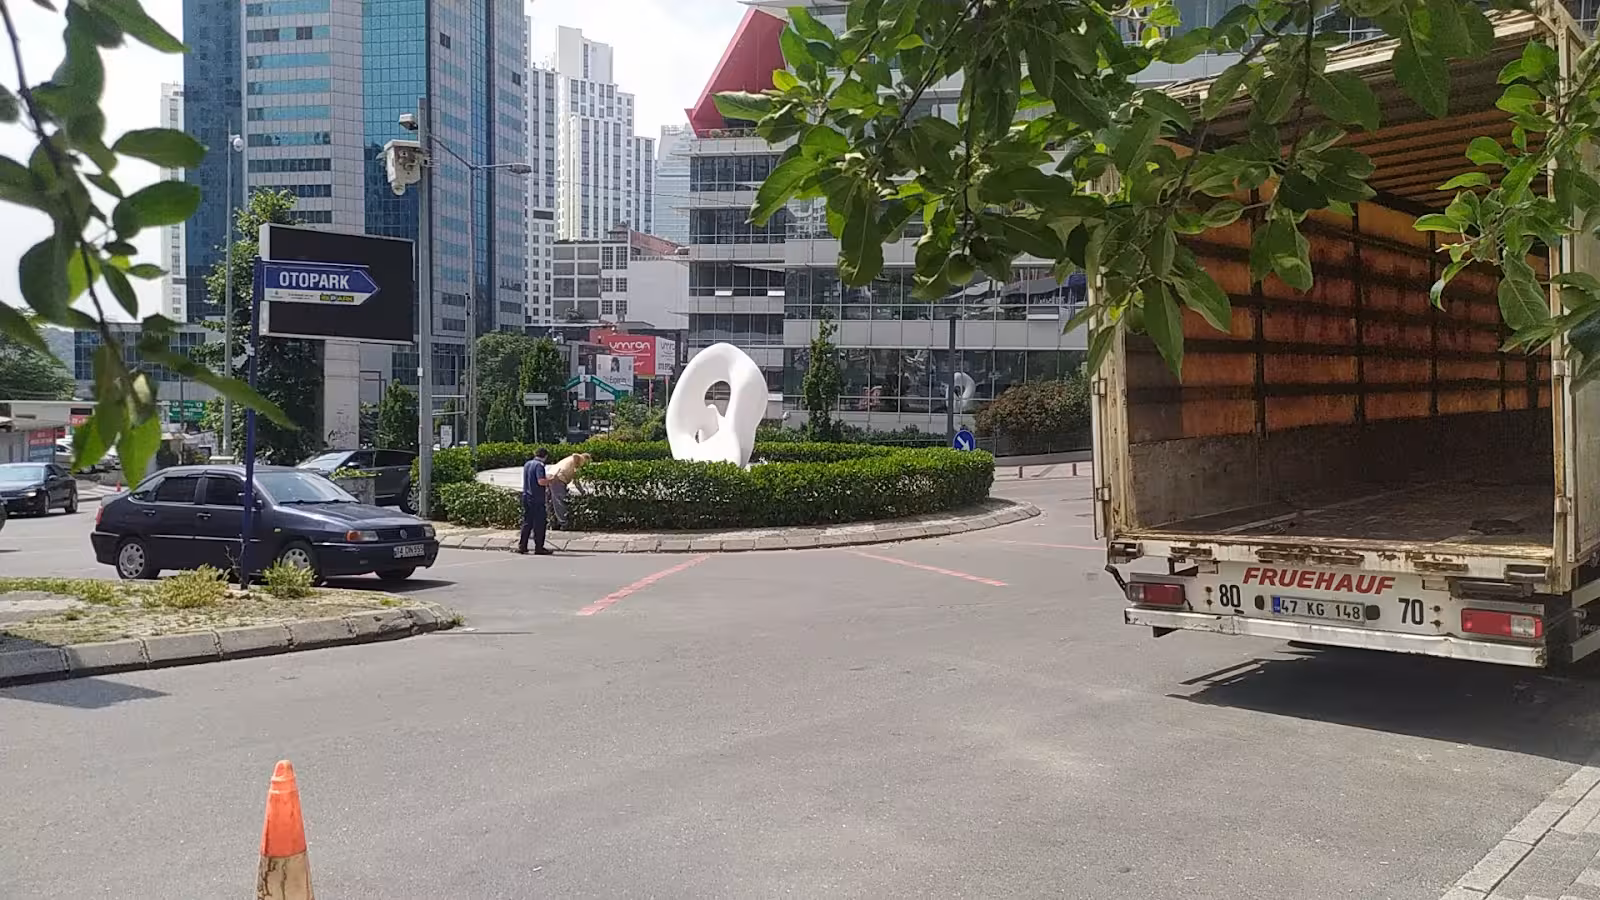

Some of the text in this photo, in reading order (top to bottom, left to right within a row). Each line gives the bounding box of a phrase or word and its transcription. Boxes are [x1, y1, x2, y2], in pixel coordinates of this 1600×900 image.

[279, 271, 350, 290] OTOPARK
[1242, 567, 1396, 595] FRUEHAUF
[1219, 584, 1241, 608] 80
[1281, 599, 1361, 620] 47 KG 148
[1398, 597, 1425, 625] 70
